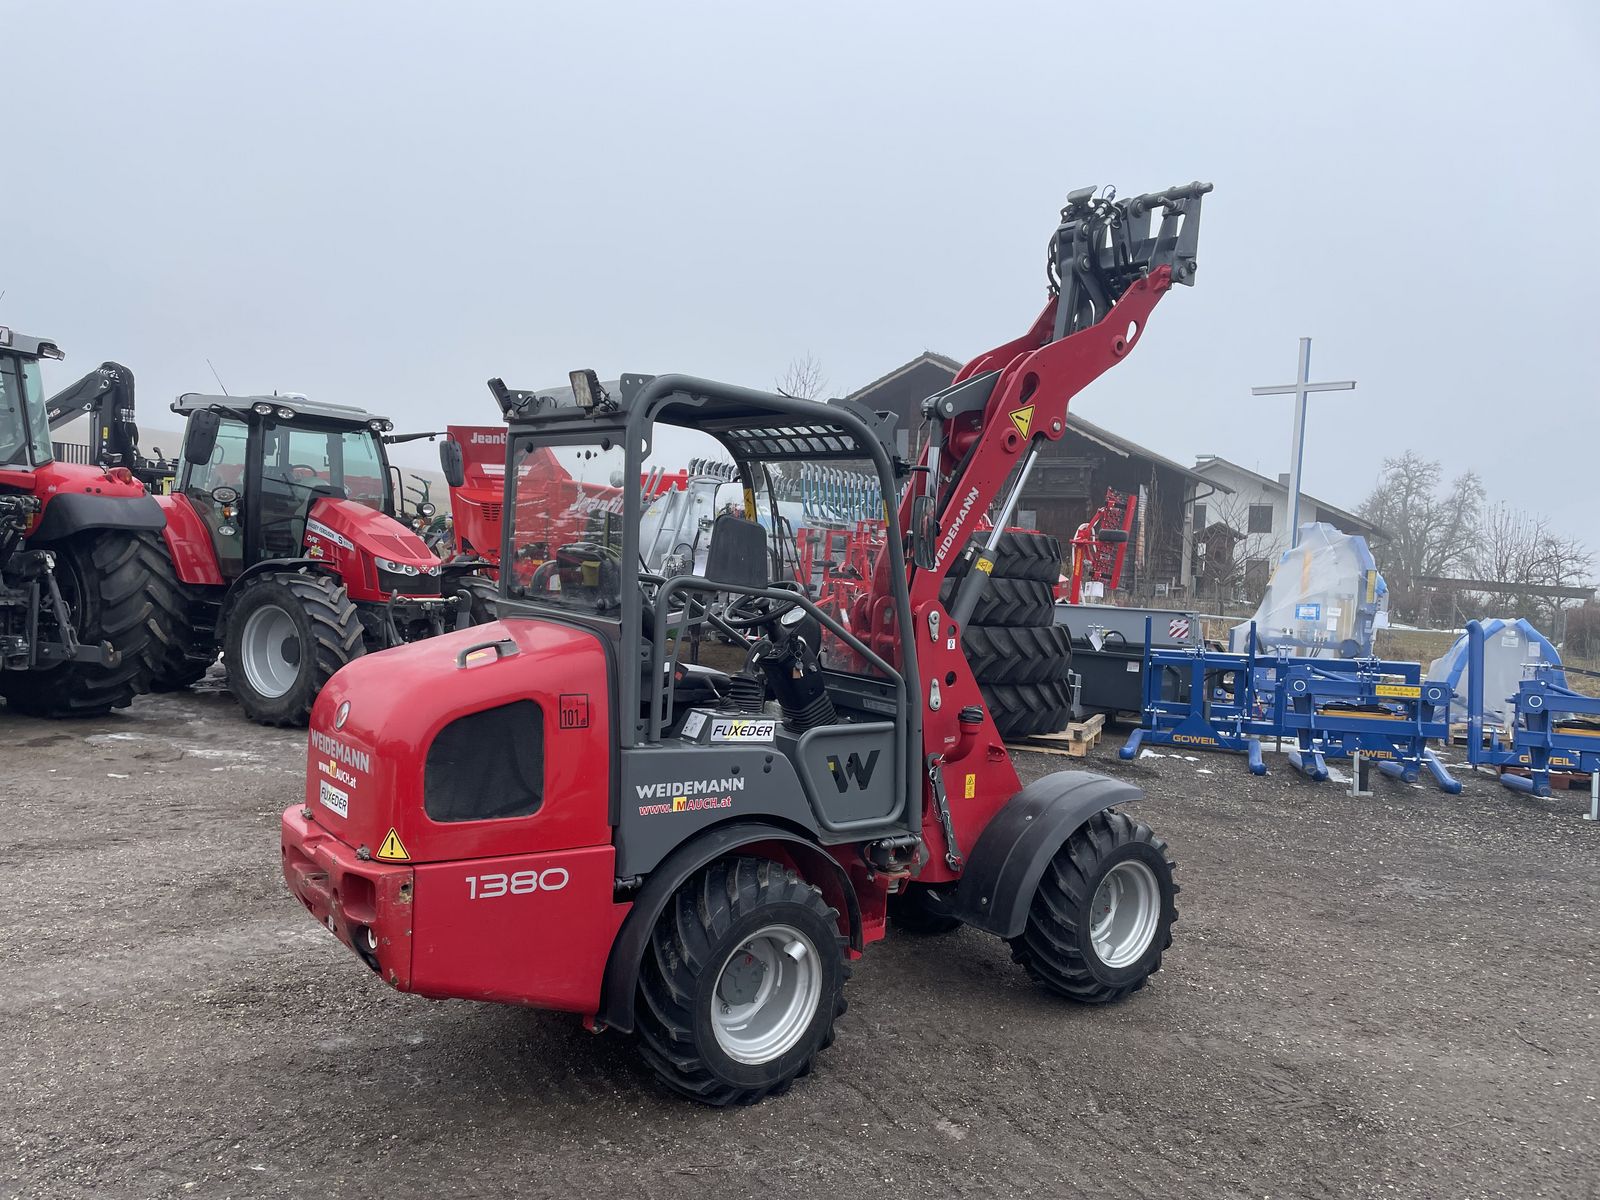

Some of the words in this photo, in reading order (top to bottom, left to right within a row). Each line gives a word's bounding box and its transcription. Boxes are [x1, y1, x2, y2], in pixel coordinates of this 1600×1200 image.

[928, 486, 980, 573] WEIDEMANN
[562, 709, 579, 726] 101
[712, 725, 773, 737] FLIXEDER
[310, 728, 370, 774] WEIDEMANN
[635, 777, 745, 799] WEIDEMANN
[639, 795, 732, 816] www.MAUCH.at
[465, 867, 569, 900] 1380
